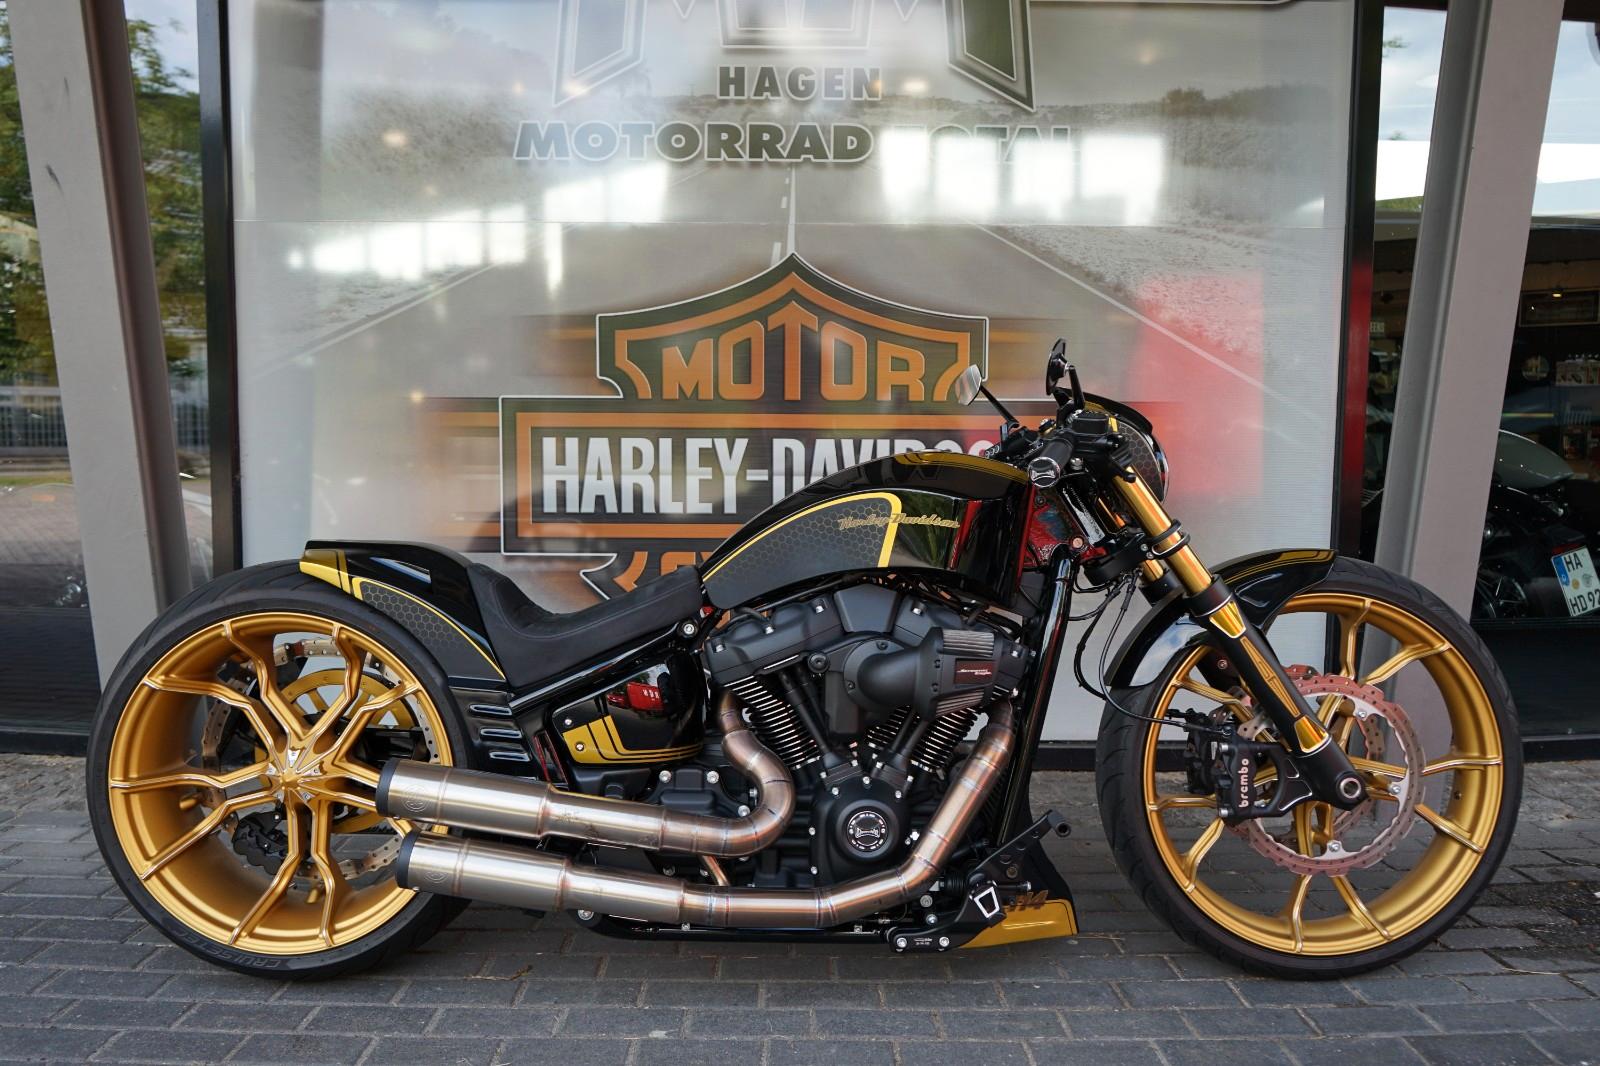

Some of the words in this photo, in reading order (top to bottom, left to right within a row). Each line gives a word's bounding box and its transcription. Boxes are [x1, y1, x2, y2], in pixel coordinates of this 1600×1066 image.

[716, 65, 882, 101] HAGEN
[512, 120, 874, 163] MOTORRAD
[661, 300, 926, 401] MOTOR
[1563, 552, 1583, 573] HA
[1569, 594, 1588, 615] HD
[1237, 758, 1250, 808] brembo
